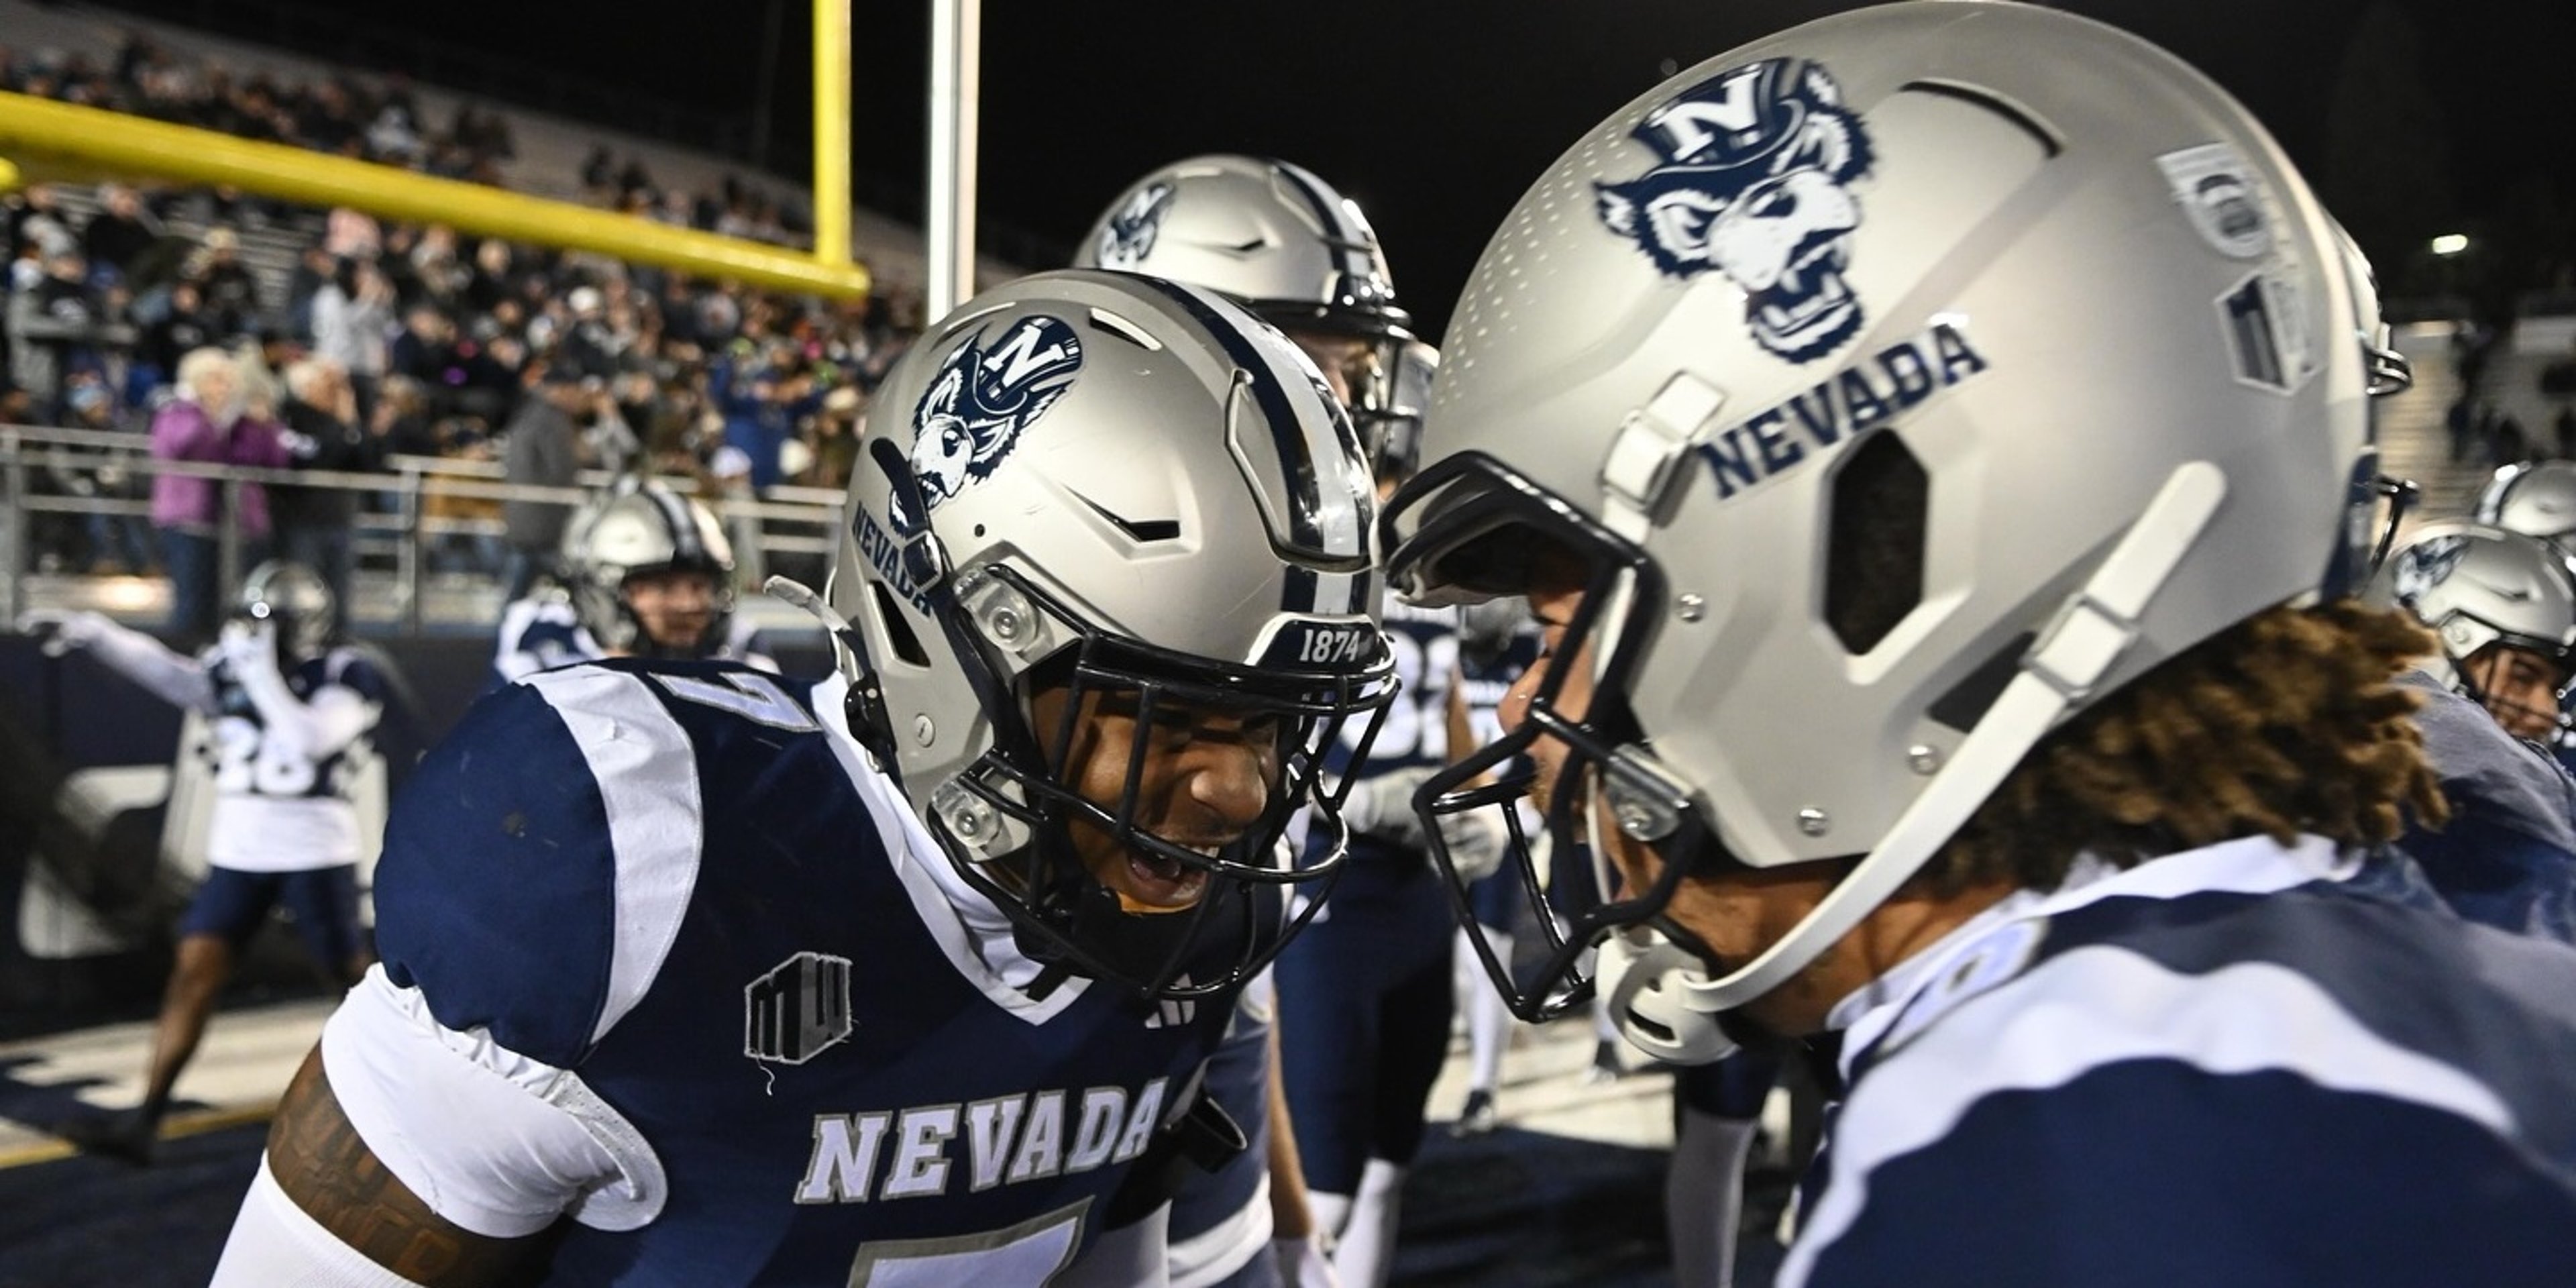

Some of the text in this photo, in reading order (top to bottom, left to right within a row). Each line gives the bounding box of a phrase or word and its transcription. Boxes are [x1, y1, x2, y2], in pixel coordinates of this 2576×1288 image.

[1648, 68, 1763, 162] N
[983, 325, 1065, 387] N
[1697, 323, 1987, 498] NEVADA
[1298, 629, 1360, 663] 1874
[647, 672, 823, 732] 7
[794, 1076, 1169, 1203] NEVADA
